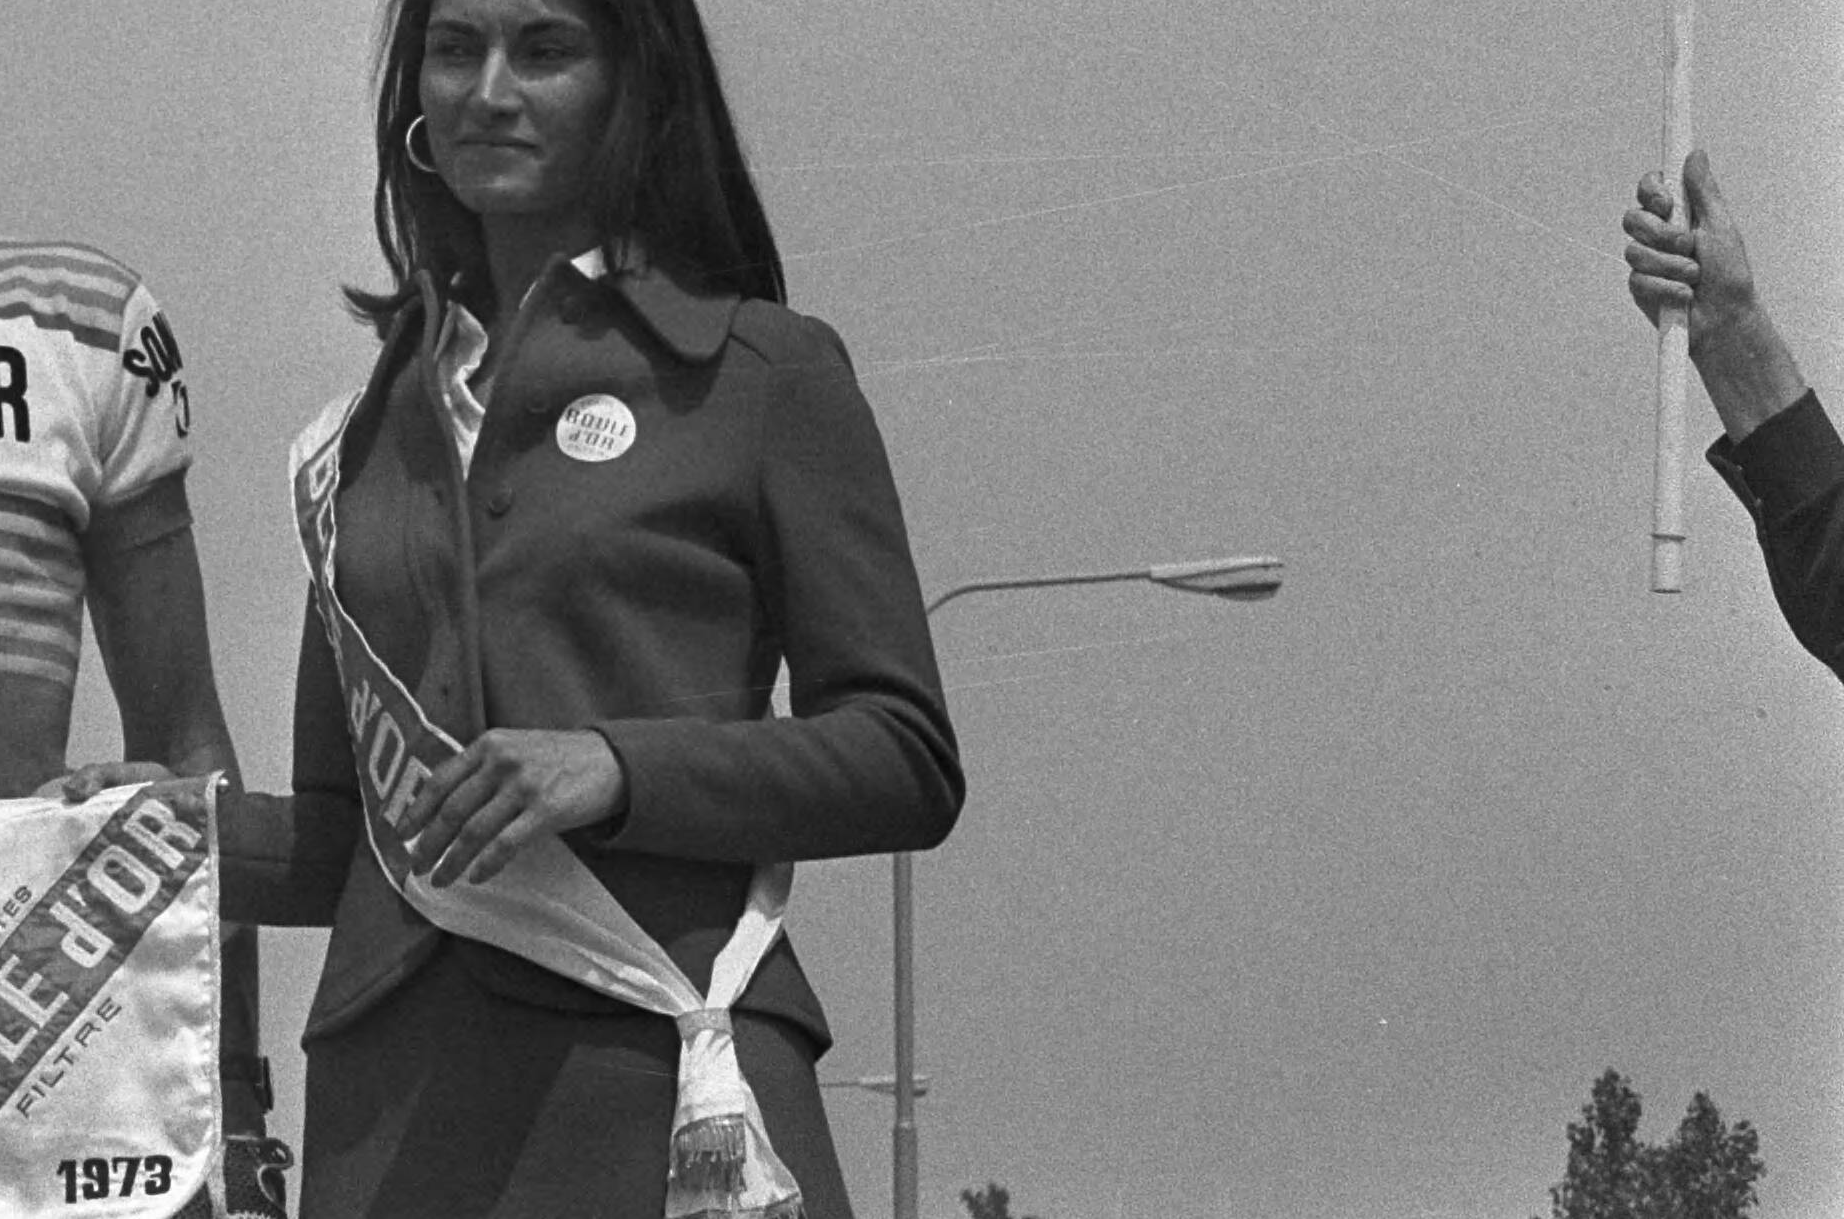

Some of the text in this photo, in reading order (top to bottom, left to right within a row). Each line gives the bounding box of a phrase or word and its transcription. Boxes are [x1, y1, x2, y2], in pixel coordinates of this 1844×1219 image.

[49, 798, 202, 969] d'OR
[15, 996, 122, 1118] FILTRE
[56, 1155, 174, 1204] 1973
